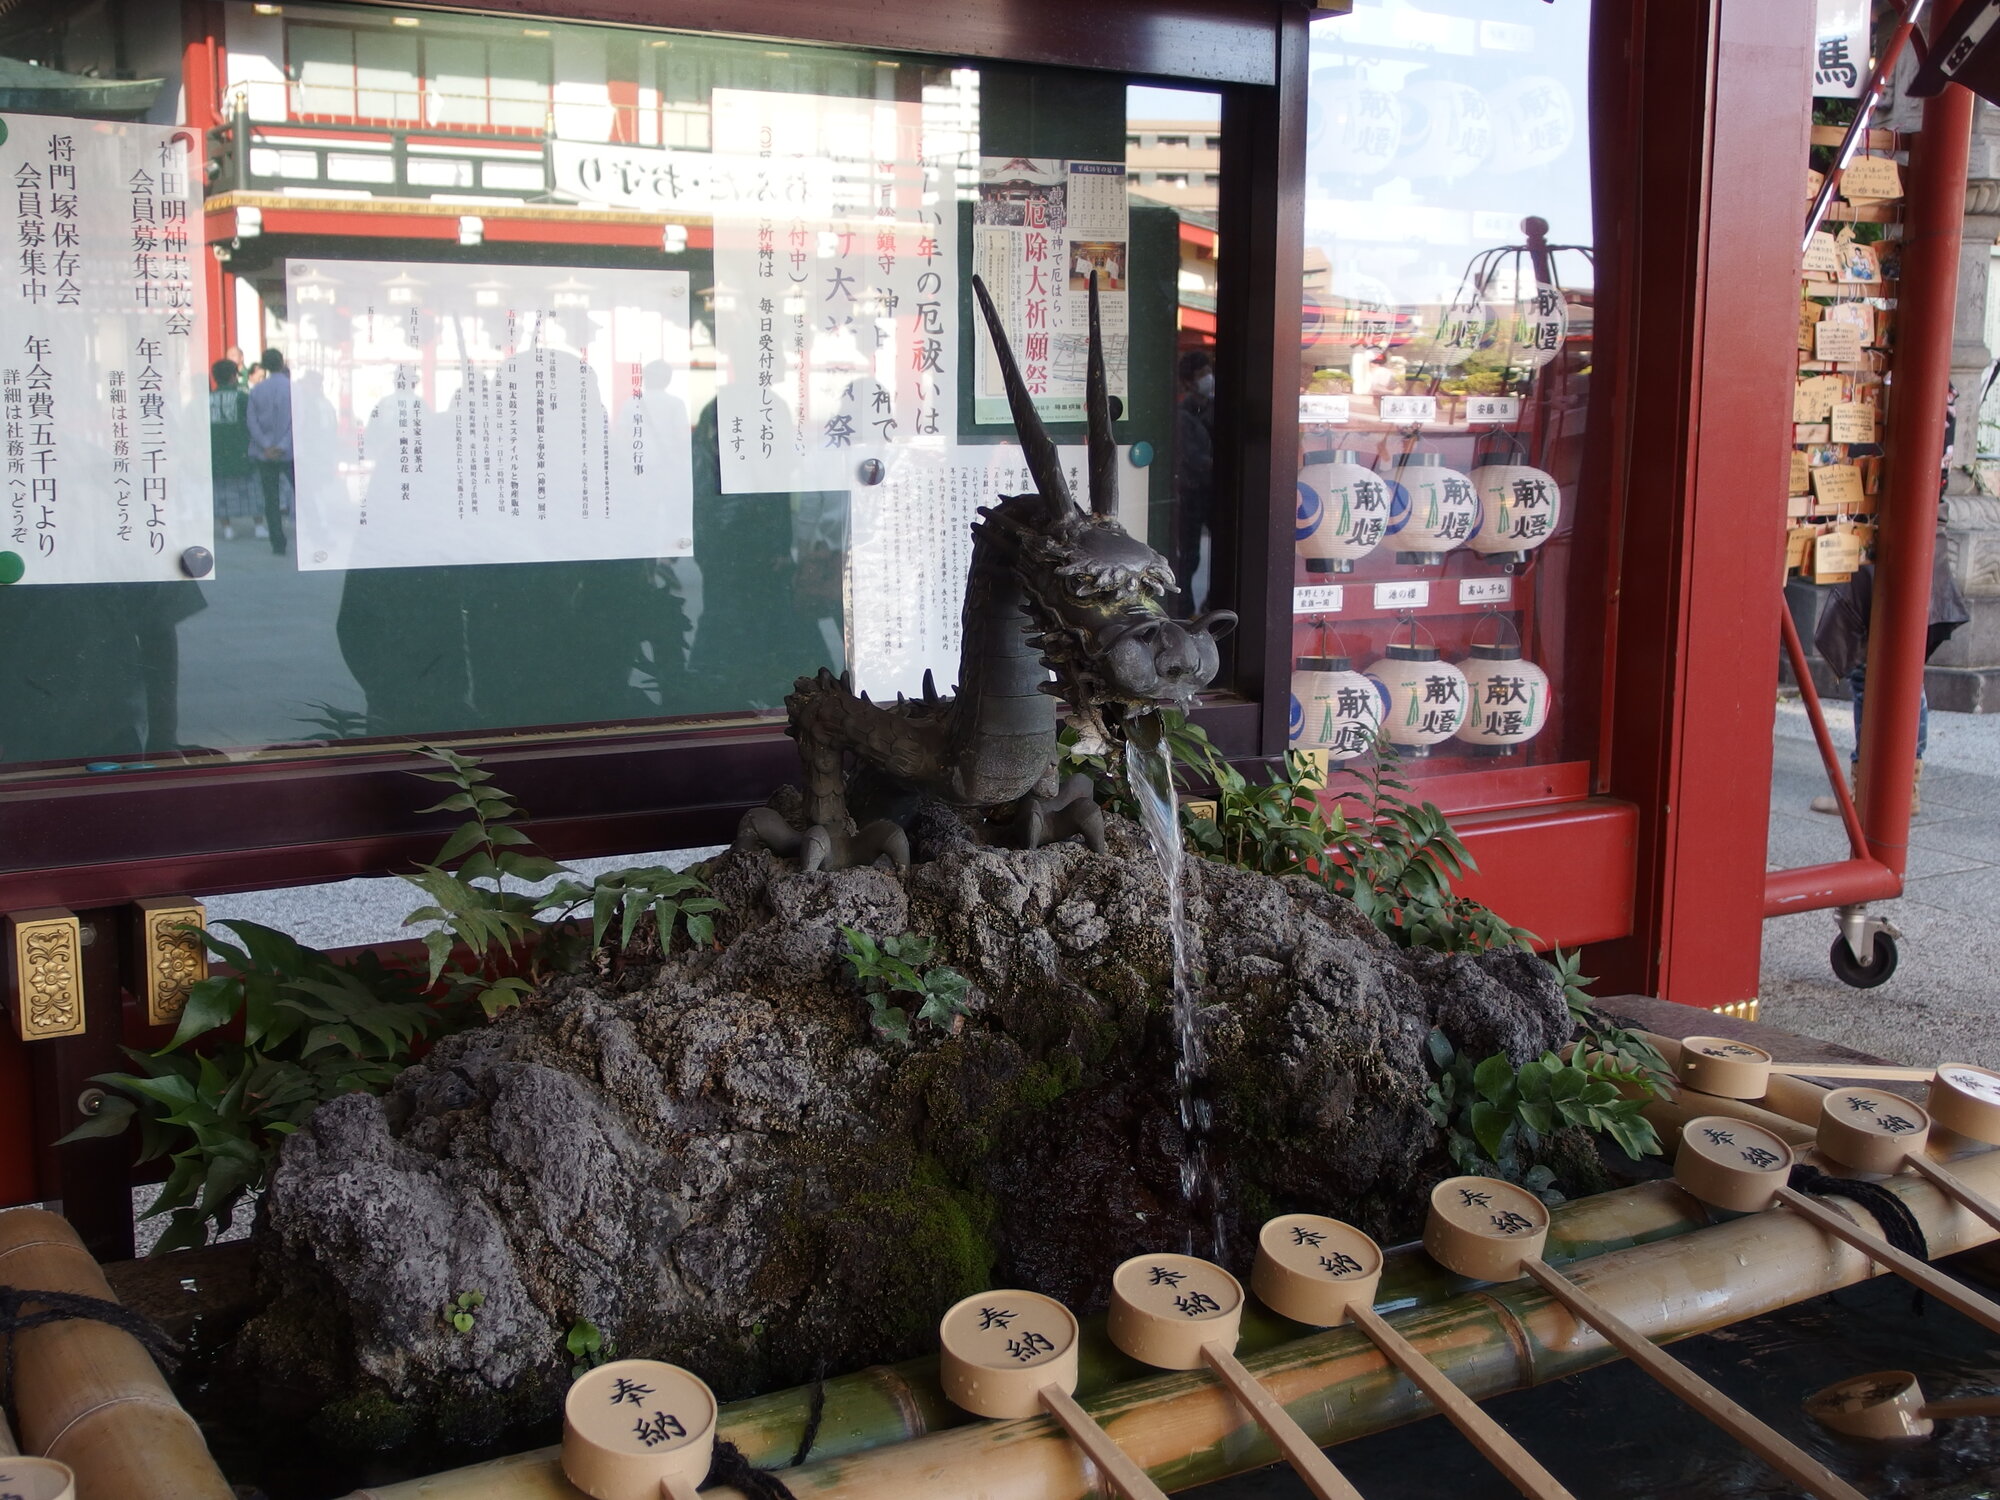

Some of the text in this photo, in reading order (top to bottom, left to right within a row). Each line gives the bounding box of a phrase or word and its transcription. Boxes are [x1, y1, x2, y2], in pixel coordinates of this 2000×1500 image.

[1815, 36, 1857, 88] 馬
[48, 134, 82, 306] 将門塚保存会
[157, 141, 191, 337] 神田明神崇敬会
[1050, 186, 1064, 328] 神田明神で厄はらい
[1024, 197, 1048, 395] 厄除大祈願祭
[14, 163, 56, 556] 会員募集中 年会費五千円より
[129, 169, 167, 555] 会員募集中 年会費三千円より
[758, 297, 775, 459] 毎日受付致しており
[631, 352, 644, 476] 田明神・皐月の行事
[731, 416, 745, 461] ます。
[3, 369, 27, 543] 詳細は社務所へどうぞ
[110, 370, 132, 541] 詳細は社務所へどうぞ
[1345, 480, 1386, 545] 献燈
[1434, 477, 1475, 539] 献燈
[1510, 479, 1551, 539] 献燈
[1417, 675, 1461, 734] 献燈
[1481, 675, 1528, 736] 献燈
[1847, 1096, 1916, 1133] 奉納
[1703, 1127, 1780, 1169] 奉納
[1457, 1188, 1533, 1234] 奉納
[1292, 1226, 1364, 1276] 奉納
[1149, 1265, 1221, 1317] 奉納
[979, 1306, 1055, 1361] 奉納
[610, 1378, 687, 1447] 奉納
